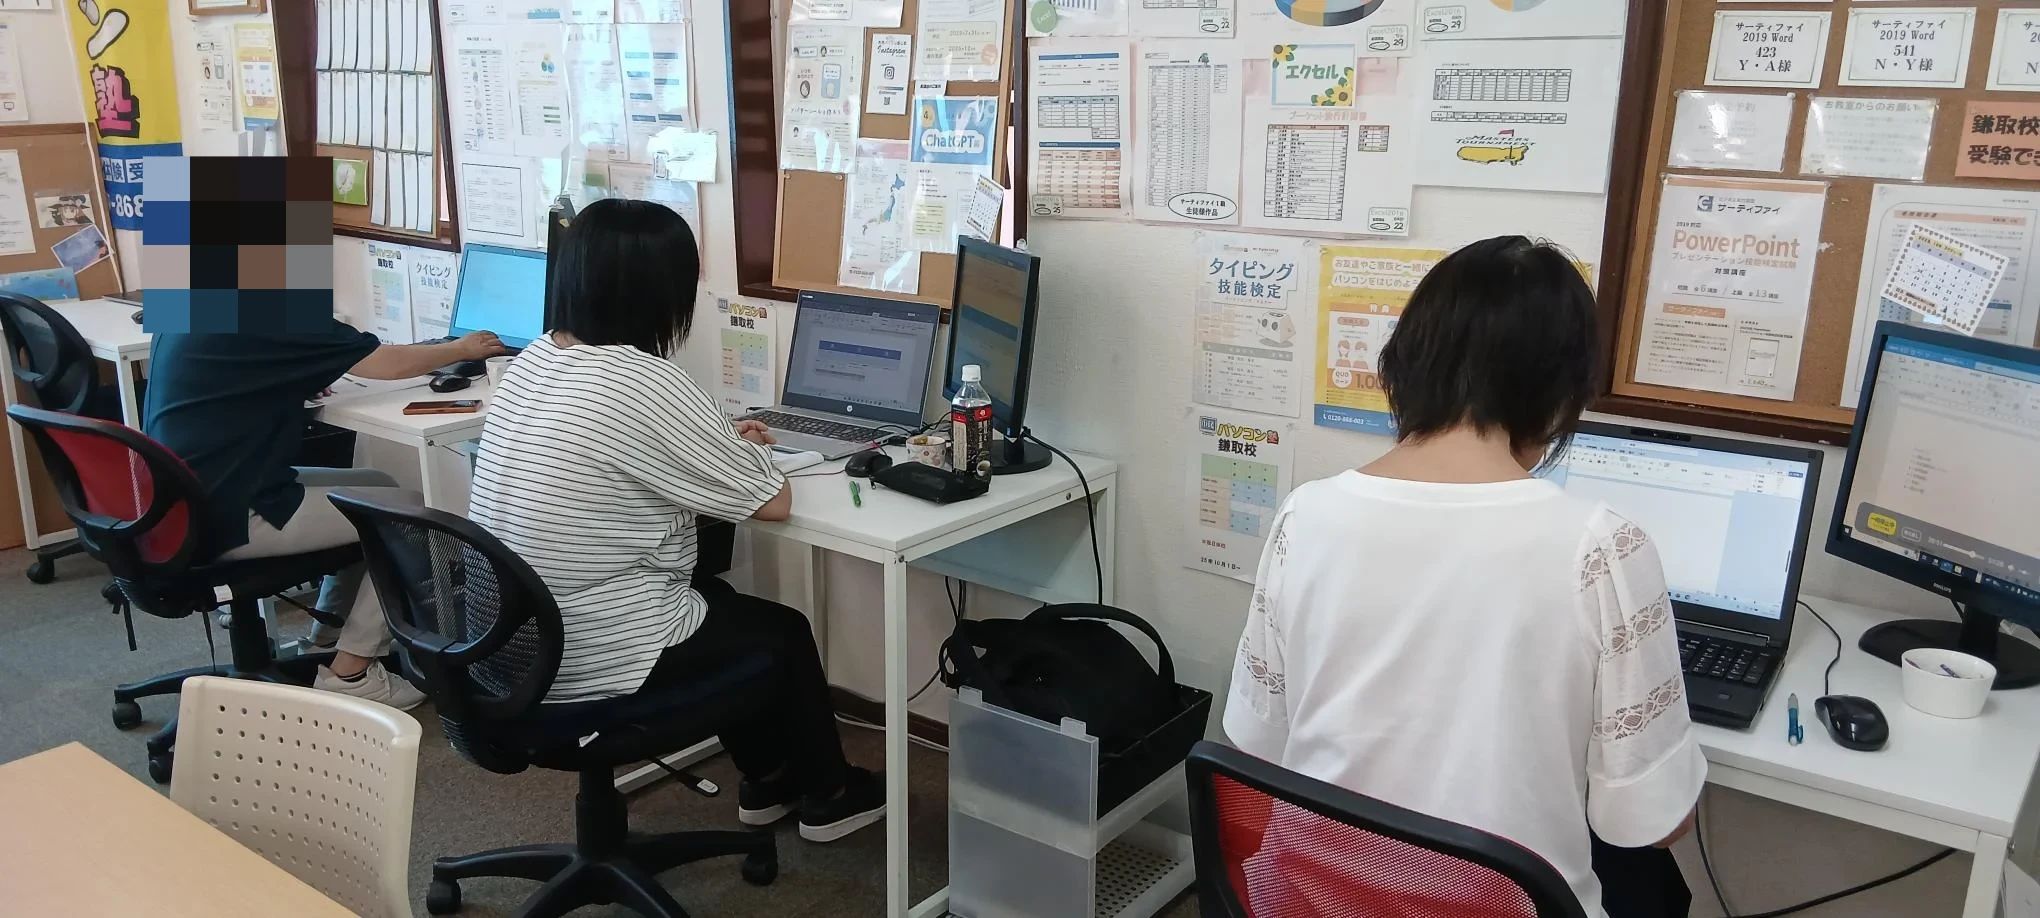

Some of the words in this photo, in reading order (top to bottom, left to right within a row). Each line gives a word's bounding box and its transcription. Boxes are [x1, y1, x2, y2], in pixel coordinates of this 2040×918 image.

[1736, 22, 1804, 32] サーティファイ
[1872, 19, 1947, 30] サーティファイ
[1742, 32, 1768, 43] 2019
[1772, 33, 1794, 43] Word
[1879, 30, 1906, 40] 2019
[1911, 30, 1936, 41] Word
[1755, 46, 1777, 58] 423
[1893, 44, 1916, 57] 541
[1285, 64, 1340, 80] エクセル
[1971, 115, 2040, 136] 鎌取校
[925, 133, 975, 148] ChatGPT
[1717, 203, 1781, 215] サーティファイ
[1672, 229, 1800, 259] PowerPoint
[416, 262, 451, 278] タイピング
[1209, 257, 1295, 281] タイピング
[1218, 279, 1282, 299] 技能検定
[1217, 422, 1279, 445] パソコン塾
[1217, 437, 1258, 457] 鎌取校
